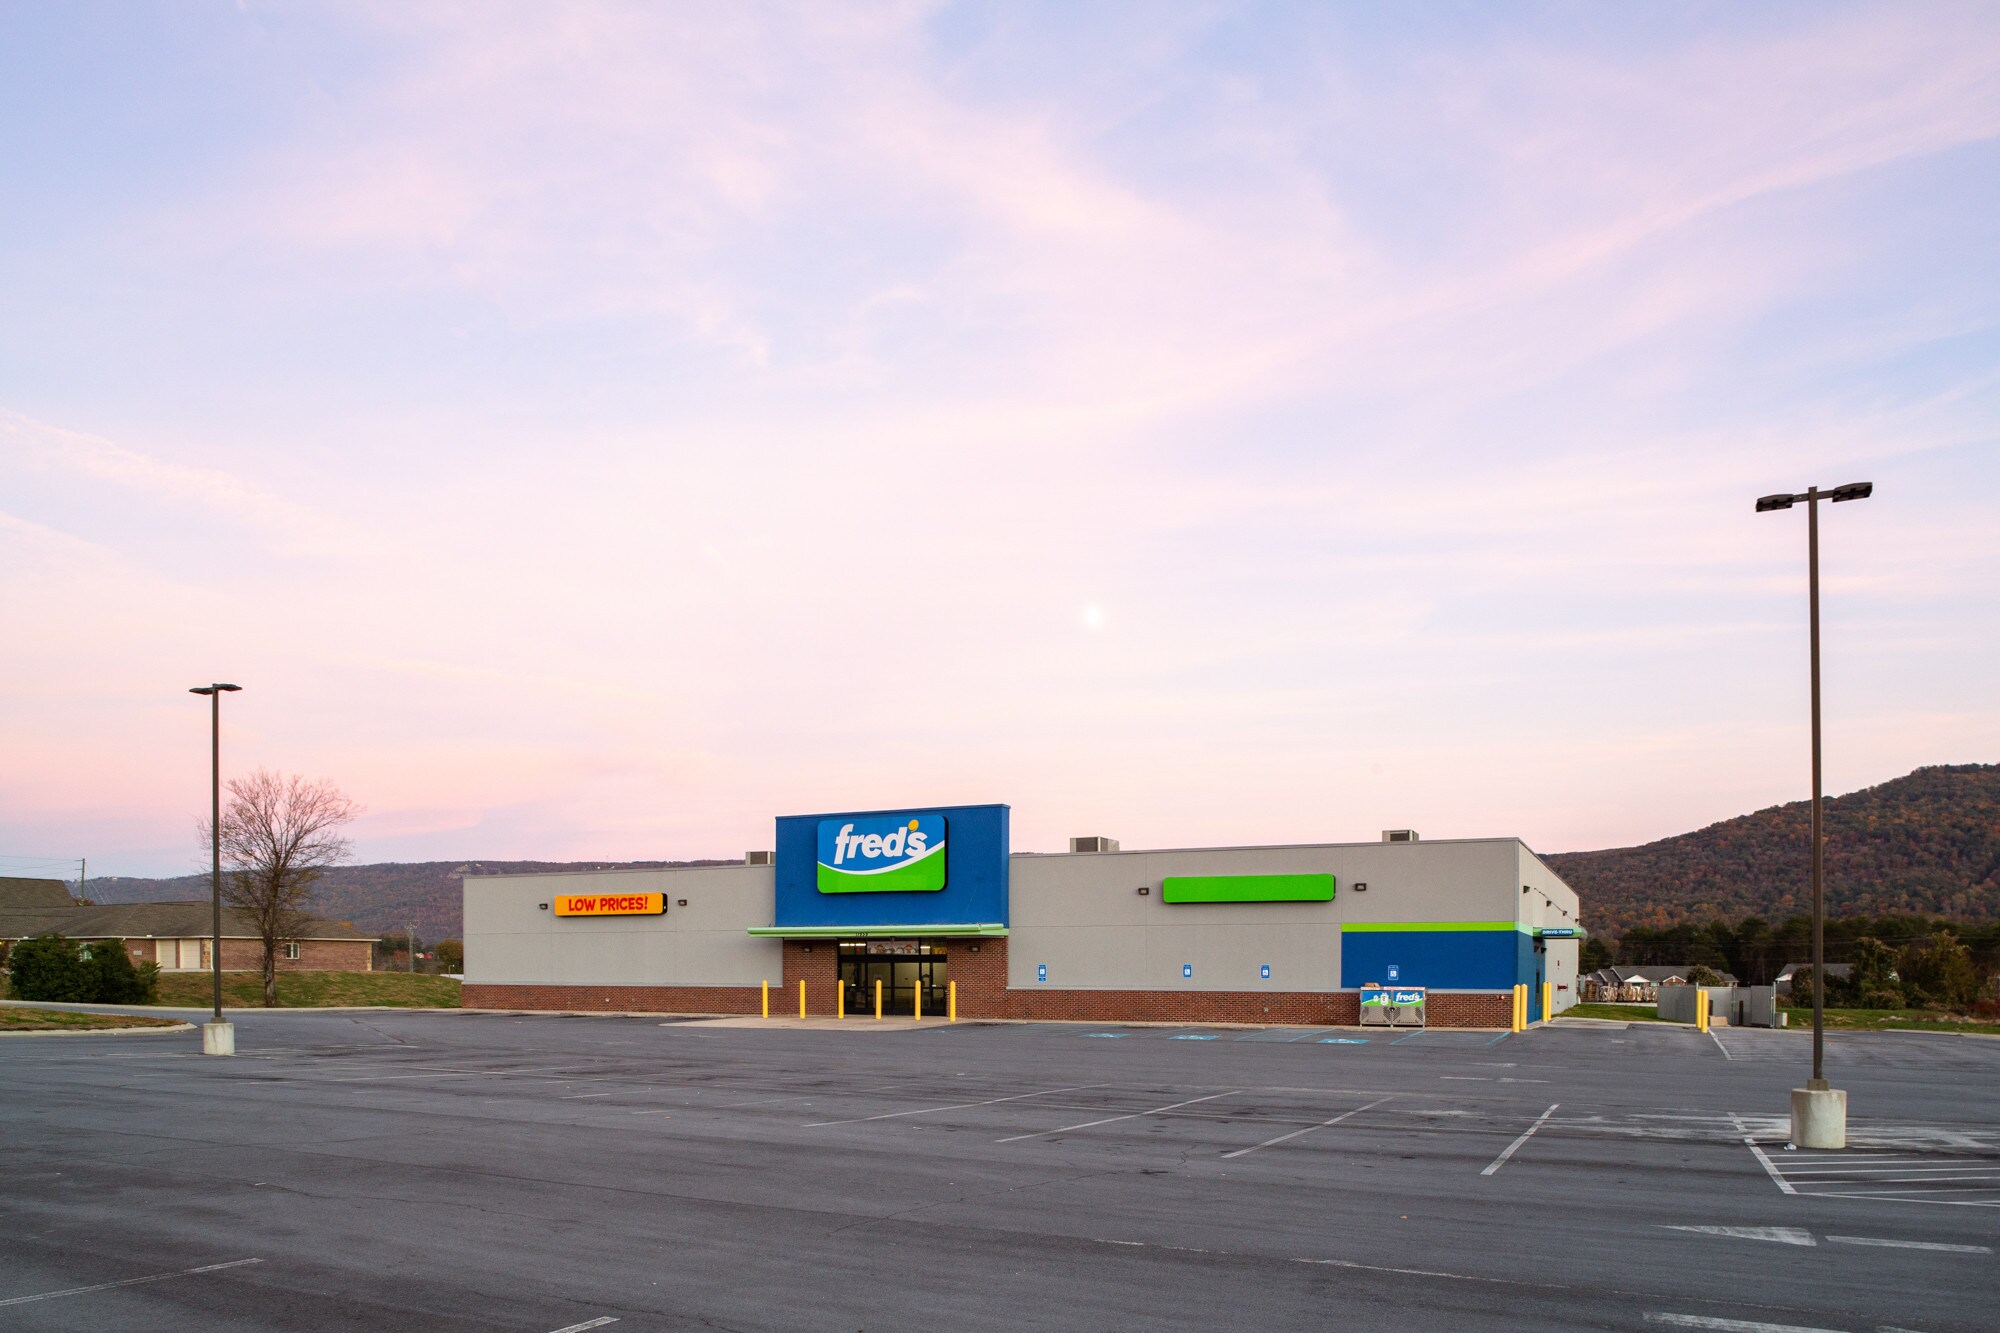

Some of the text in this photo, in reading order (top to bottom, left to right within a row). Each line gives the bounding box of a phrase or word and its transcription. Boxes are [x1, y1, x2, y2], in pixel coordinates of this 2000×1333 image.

[834, 819, 928, 864] fred's
[568, 896, 648, 911] LOW PRICES!
[1396, 992, 1420, 1002] fred's
